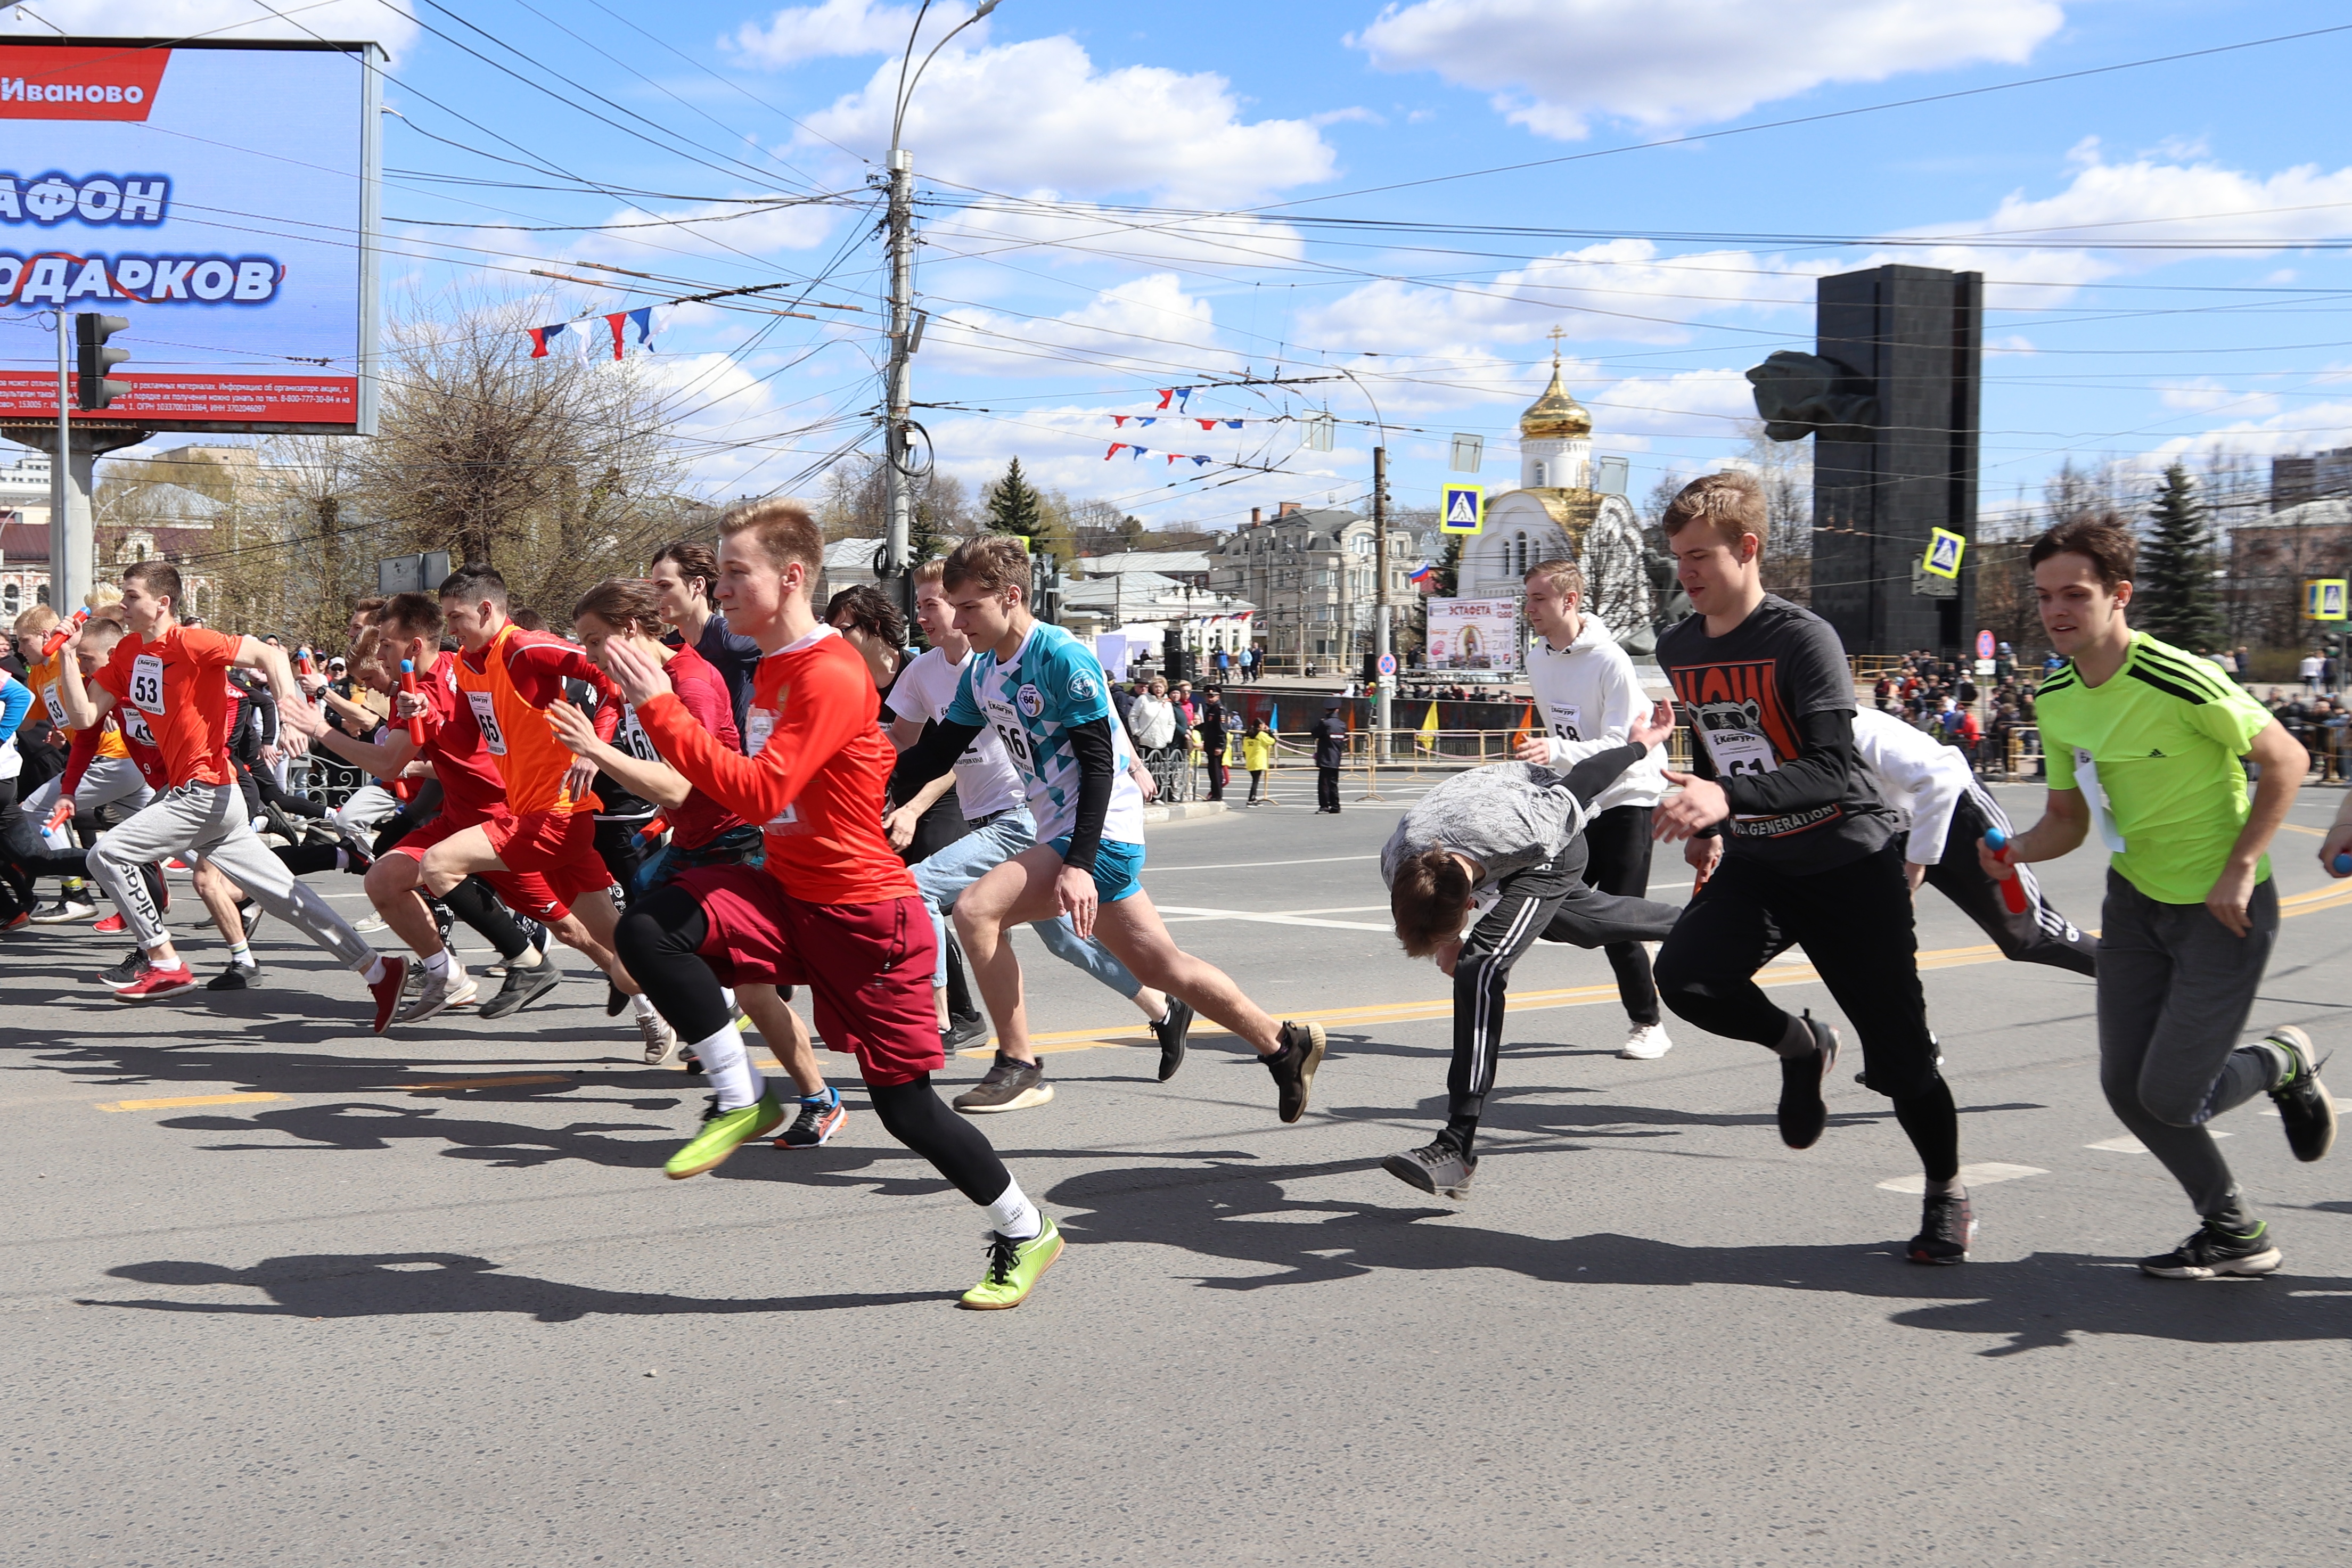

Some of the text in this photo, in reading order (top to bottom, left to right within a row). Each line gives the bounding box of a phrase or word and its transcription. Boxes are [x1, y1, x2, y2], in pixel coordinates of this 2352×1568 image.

[1, 77, 144, 104] Иваново
[219, 382, 263, 391] Информацию
[281, 395, 334, 403] 8-800-777-30-84
[1449, 606, 1491, 615] ЭСТАФЕТА
[135, 676, 158, 704] 53
[1077, 679, 1091, 691] 66
[1023, 695, 1034, 704] 66
[48, 700, 63, 720] 33
[479, 714, 499, 743] 65
[1554, 723, 1581, 742] 58
[997, 724, 1027, 760] 66
[1719, 735, 1756, 743] Кенгуру
[143, 762, 151, 775] 9
[1749, 805, 1834, 835] GENERATION
[120, 864, 163, 935] adidas
